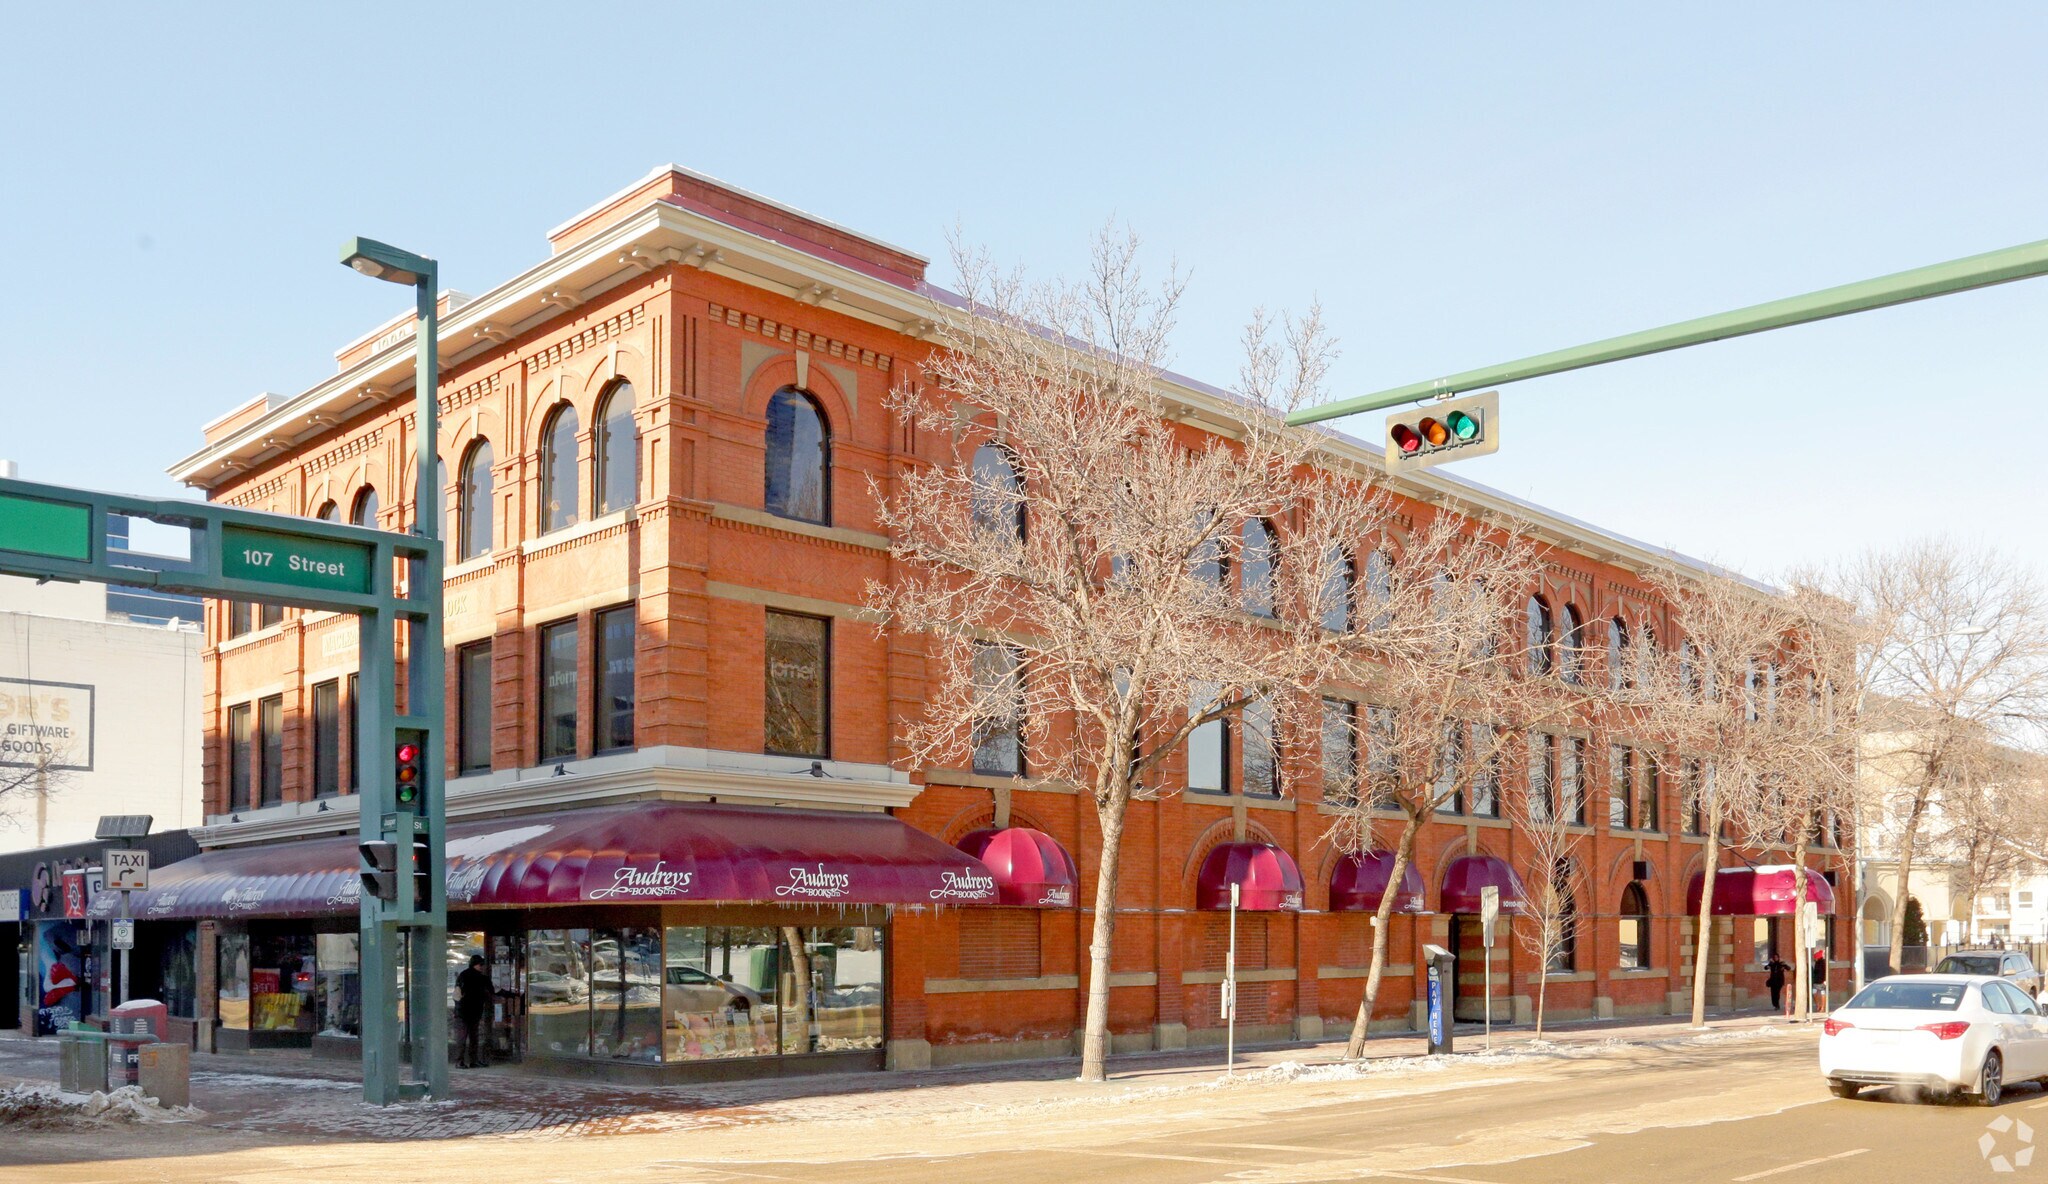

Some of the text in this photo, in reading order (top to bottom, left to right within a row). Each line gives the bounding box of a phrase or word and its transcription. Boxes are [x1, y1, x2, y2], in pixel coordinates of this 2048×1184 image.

[242, 549, 345, 577] 107 Street
[7, 723, 70, 739] GIFTWARE
[1, 740, 52, 755] GOODS
[111, 854, 144, 867] TAXI
[591, 861, 692, 897] Audreys
[776, 863, 849, 895] Audreys
[930, 867, 994, 898] Audreys
[629, 885, 664, 897] BOOKS
[805, 888, 830, 898] BOOKS
